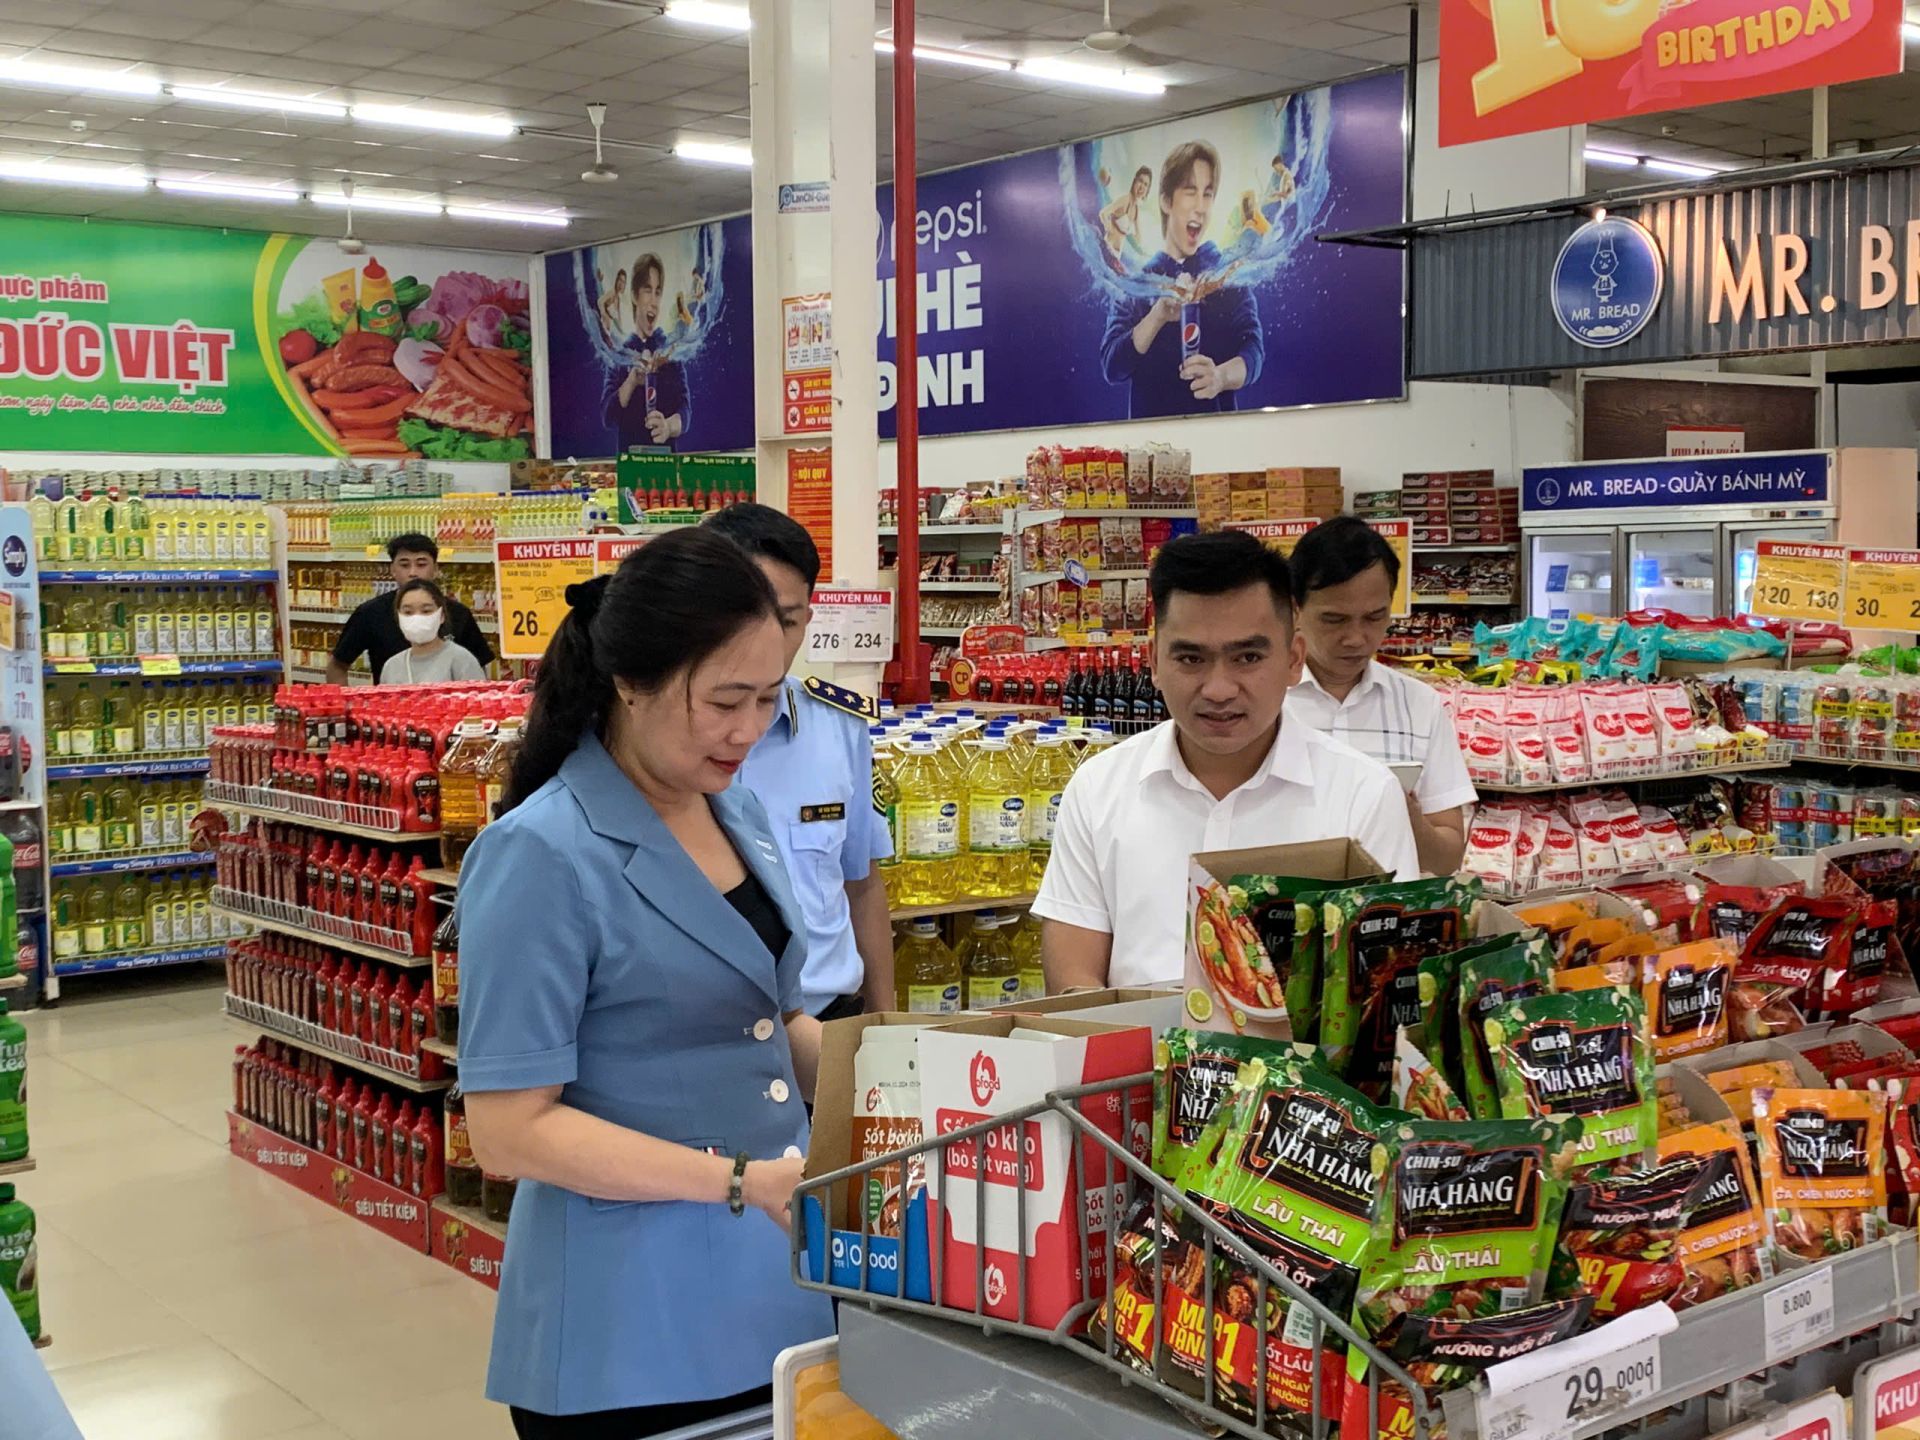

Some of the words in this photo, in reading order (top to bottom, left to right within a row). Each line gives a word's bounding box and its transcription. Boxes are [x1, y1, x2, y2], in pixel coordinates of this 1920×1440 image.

[1657, 0, 1854, 68] BIRTHDAY
[891, 189, 987, 261] epsi
[917, 251, 983, 334] HÈ
[1709, 234, 1836, 324] MR.
[1570, 308, 1594, 322] MR.
[1598, 303, 1640, 320] BREAD
[113, 324, 231, 390] VIỆT
[877, 350, 985, 412] ĐNH
[1568, 481, 1597, 497] MR.
[1722, 470, 1772, 492] BÁNH
[1759, 585, 1790, 605] 120
[1806, 589, 1839, 610] 130
[1855, 597, 1879, 617] 30
[1910, 600, 1920, 618] 2
[512, 609, 538, 637] 26
[812, 633, 839, 649] 276
[854, 633, 881, 648] 234
[955, 671, 968, 685] CP
[1360, 917, 1398, 935] CHIN-SU
[438, 968, 458, 985] GOL
[1575, 1055, 1622, 1088] HÀNG
[972, 1151, 992, 1172] st
[1268, 1126, 1316, 1170] NHÀ
[1405, 1155, 1462, 1170] CHIN-SU
[356, 1199, 375, 1216] SIÊU
[1402, 1182, 1441, 1215] NHÀ
[1447, 1176, 1514, 1206] HÀNG
[1252, 1195, 1294, 1223] LẨU
[1299, 1215, 1348, 1249] THÁI
[471, 1256, 492, 1276] SIÊU
[849, 1243, 898, 1271] Oood
[1450, 1243, 1500, 1271] THÁI
[1595, 1262, 1632, 1313] 1
[1783, 1290, 1812, 1315] 8.800
[1127, 1303, 1156, 1353] 1
[1216, 1322, 1240, 1376] 1
[1257, 1343, 1282, 1362] ỐT
[1433, 1340, 1495, 1358] NƯỚNG
[1252, 1362, 1279, 1384] NẬN
[1281, 1377, 1312, 1393] NGAY
[1564, 1366, 1604, 1420] 29
